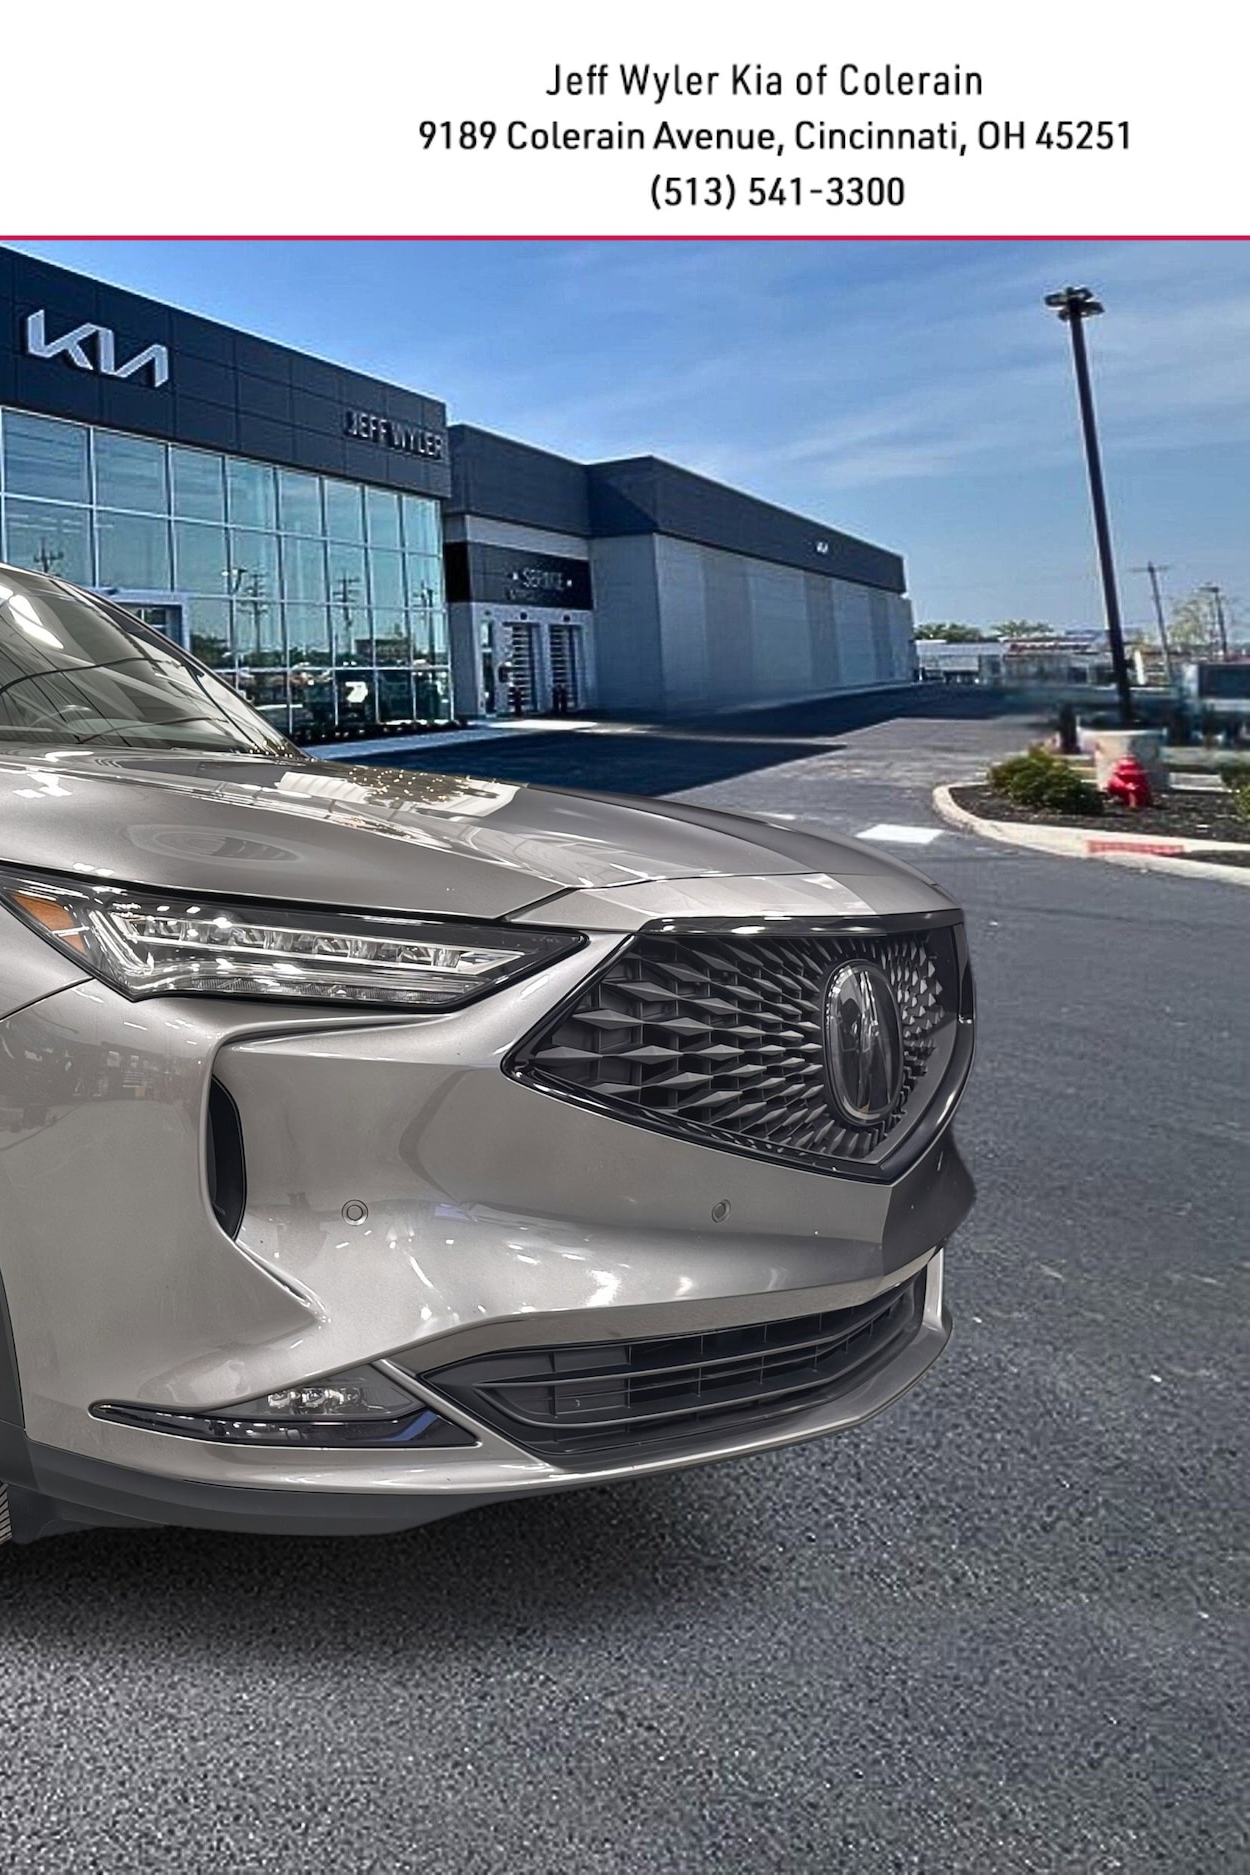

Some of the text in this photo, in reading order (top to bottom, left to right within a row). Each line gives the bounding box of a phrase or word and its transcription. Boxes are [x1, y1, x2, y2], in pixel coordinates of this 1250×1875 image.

[26, 308, 169, 388] KIA
[348, 410, 443, 459] JEFF WYLER
